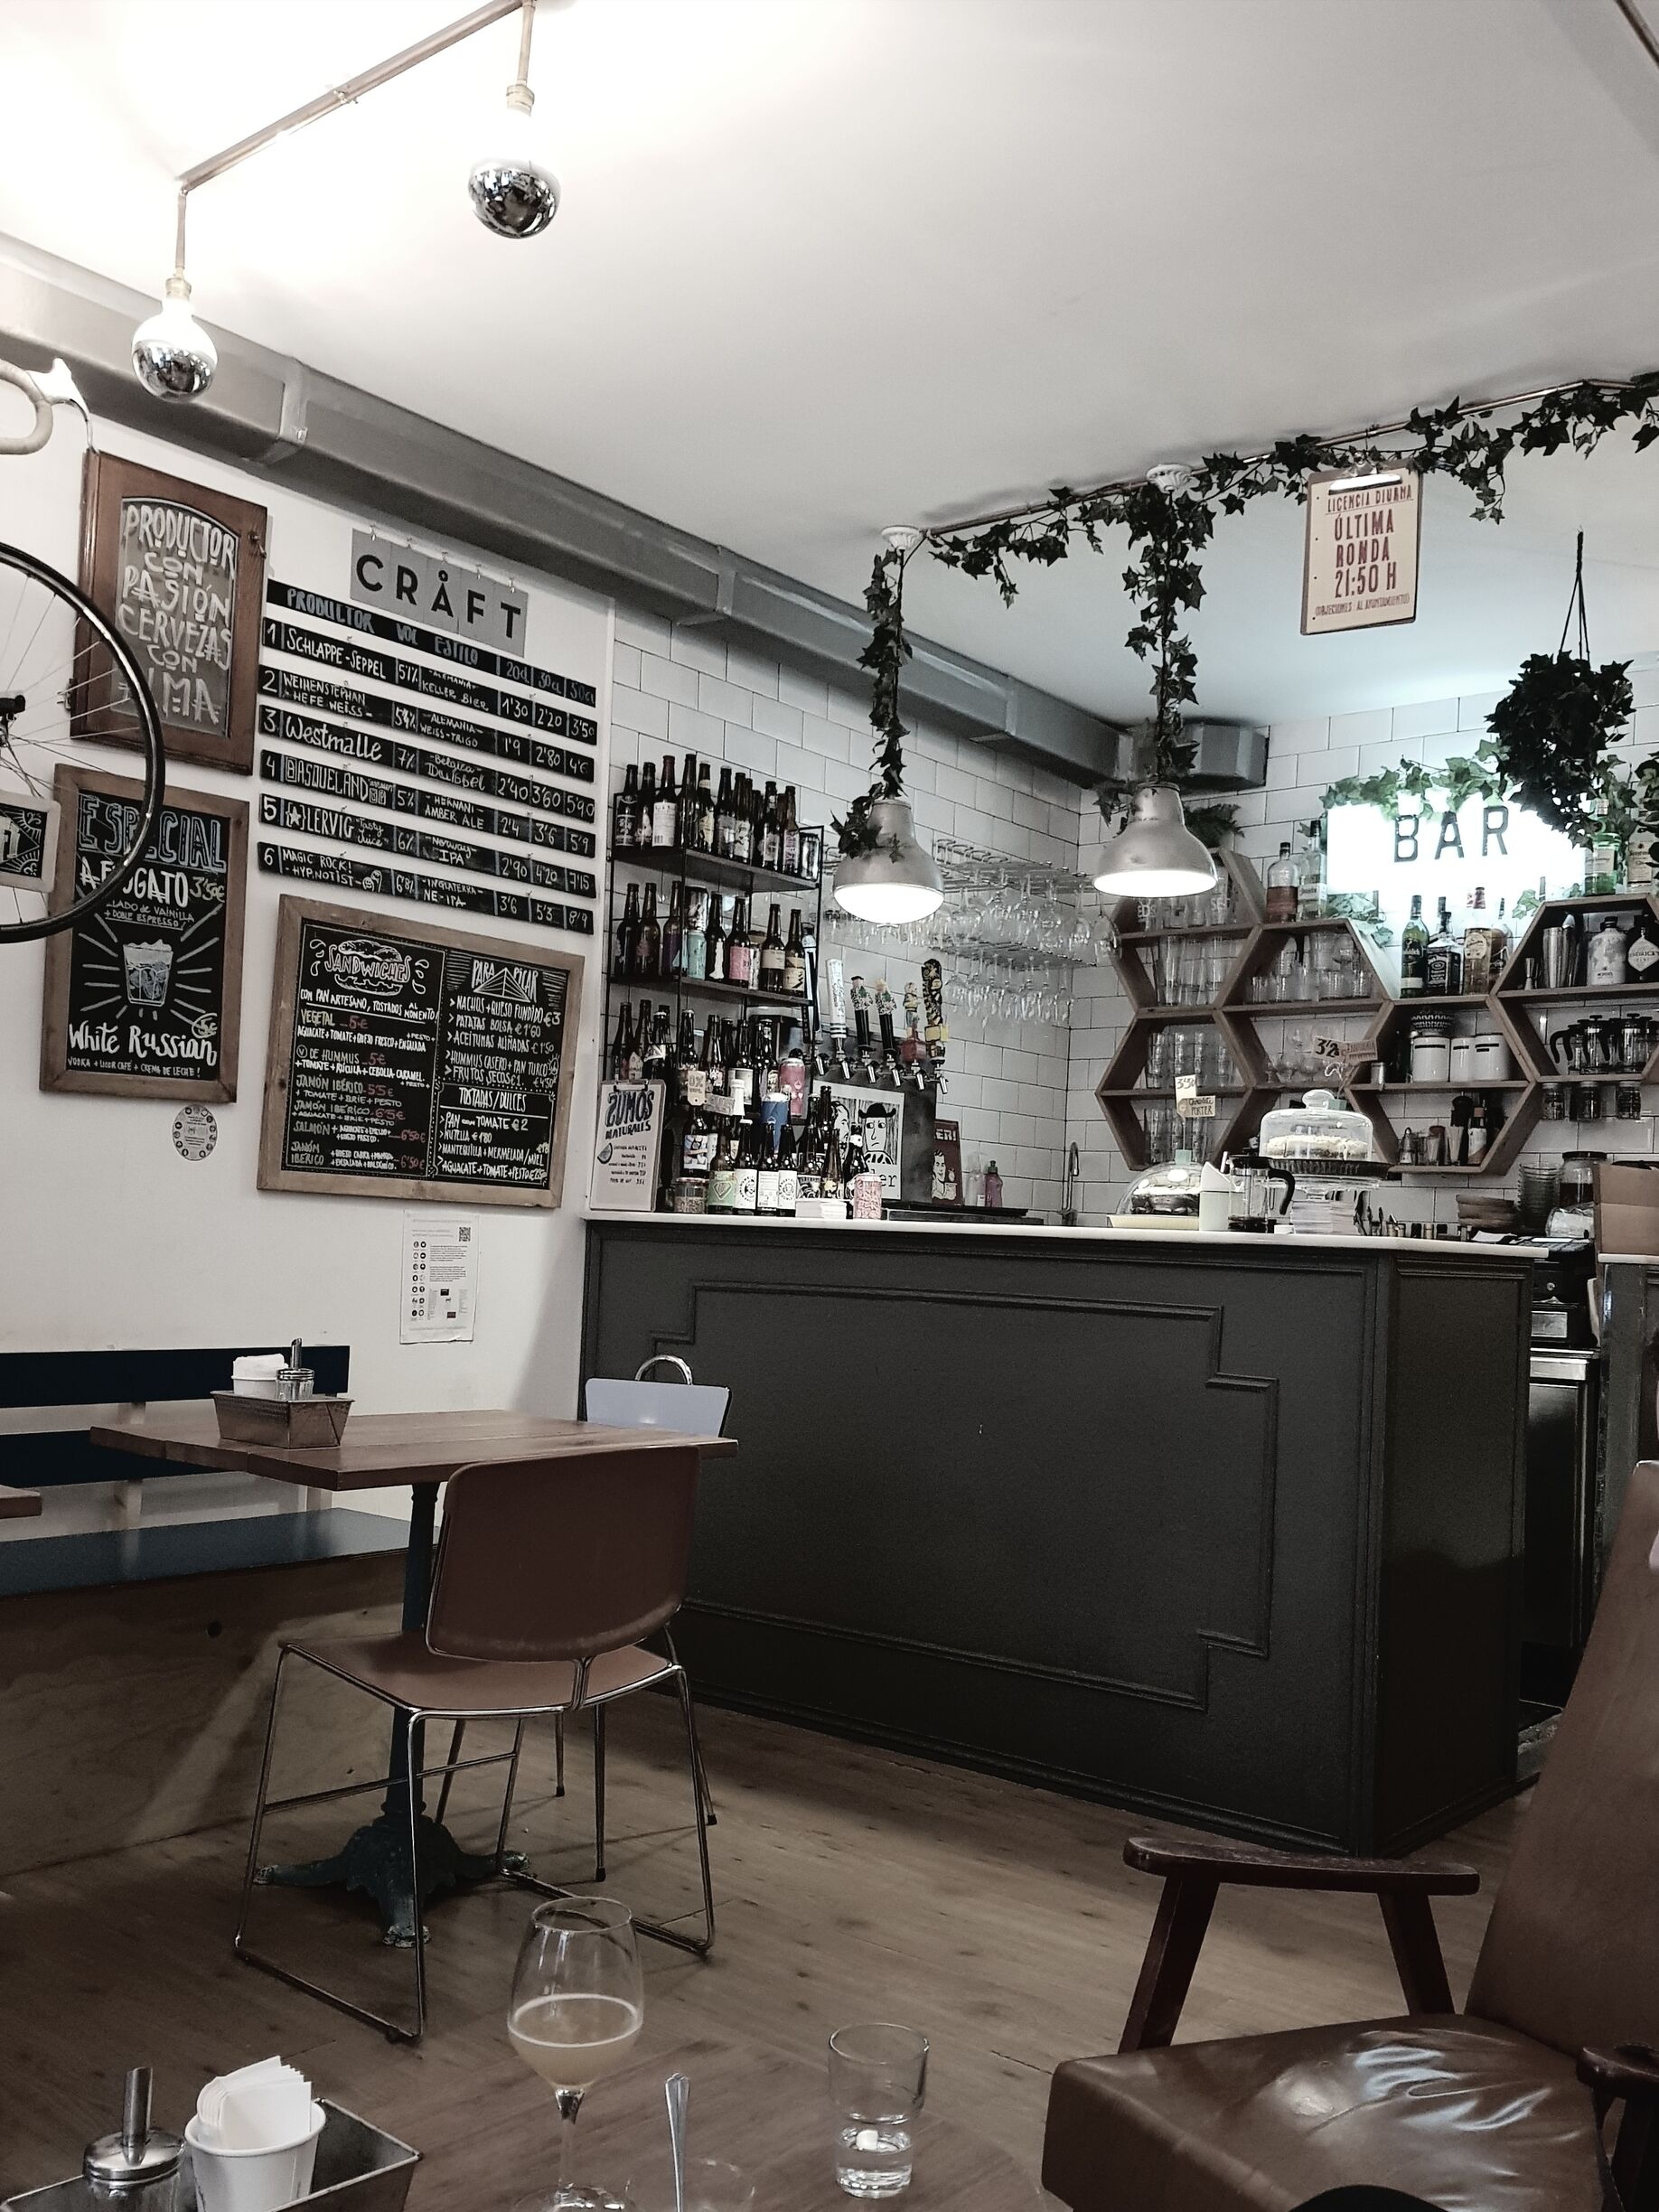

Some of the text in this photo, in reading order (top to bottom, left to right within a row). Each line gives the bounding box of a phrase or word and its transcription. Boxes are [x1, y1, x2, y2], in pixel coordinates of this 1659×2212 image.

[1327, 492, 1370, 513] LICENCIA
[1334, 508, 1394, 542] ÚLTIMA
[125, 504, 236, 580] PRODUCTOR
[1336, 536, 1390, 568] RONDA
[145, 551, 204, 586] CON
[1334, 561, 1397, 599] 21:50 H
[123, 565, 230, 628] PASIÓN
[356, 554, 521, 640] CRÅFT
[118, 603, 232, 670] CERVEZAS
[267, 623, 276, 645] 1
[287, 588, 375, 634] PRODUCTOR
[434, 635, 479, 666] ESTILO
[146, 643, 199, 673] CON
[294, 691, 324, 708] HEFE
[422, 680, 595, 738] KELLER BIER 1'30 2'20 3'50
[262, 670, 277, 693] 2
[283, 672, 366, 706] WEIHENSTEPHAN
[536, 745, 561, 767] 2'80
[264, 708, 595, 818] 3 Westmalle 7% 2'40 3'60 5'90
[266, 755, 276, 778] 4
[286, 756, 370, 802] BASQUELAND
[398, 790, 415, 807] 5%
[500, 816, 520, 838] 2'4
[534, 822, 558, 846] 3'6
[570, 833, 589, 854] 5'9
[425, 803, 485, 830] AMBER ALE
[79, 795, 227, 874] ESPCIAL
[263, 795, 277, 821] 5
[398, 831, 415, 851] 6%
[501, 857, 528, 879] 2'90
[536, 864, 558, 885] 4'20
[569, 872, 590, 891] 7'15
[1393, 805, 1509, 863] BAR
[438, 849, 464, 866] IPA
[264, 848, 588, 928] 6 MAGIC ROCK! 6'8% 3'6 5'3 8'9
[112, 911, 134, 922] DOBLE
[324, 944, 413, 983] SANDWICHES
[471, 959, 495, 989] PARA
[300, 989, 314, 1001] CON
[315, 989, 331, 1004] PAN
[372, 999, 403, 1017] TOSTADOS
[408, 1002, 418, 1010] AL
[456, 995, 485, 1014] NACHOS
[300, 1008, 336, 1027] VEGETAL
[455, 1014, 486, 1031] PATATAS
[490, 1018, 512, 1035] BOLSA
[69, 1020, 218, 1067] White Russian
[68, 1055, 91, 1067] VODKA
[163, 1066, 171, 1075] DE
[309, 1048, 320, 1060] DE
[322, 1049, 361, 1064] HUMMUS
[450, 1050, 483, 1068] HUMMUS
[483, 1054, 508, 1071] CASERO
[513, 1059, 527, 1074] PAN
[528, 1061, 548, 1078] TURCO
[453, 1065, 485, 1083] FRUTOS
[485, 1070, 511, 1084] SECOS
[295, 1073, 329, 1092] JAMÓN
[333, 1077, 363, 1094] IBÉRICO
[294, 1100, 326, 1112] JAMÓN
[304, 1090, 338, 1101] TOMATE
[374, 1097, 403, 1108] PESTO
[293, 1120, 331, 1136] SALMÓN
[444, 1129, 471, 1142] NUTELLA
[445, 1111, 461, 1129] PAN
[475, 1115, 511, 1129] TOMATE
[933, 1128, 958, 1141] ER!
[290, 1139, 321, 1153] JAMÓN
[441, 1159, 478, 1176] AGUACATE
